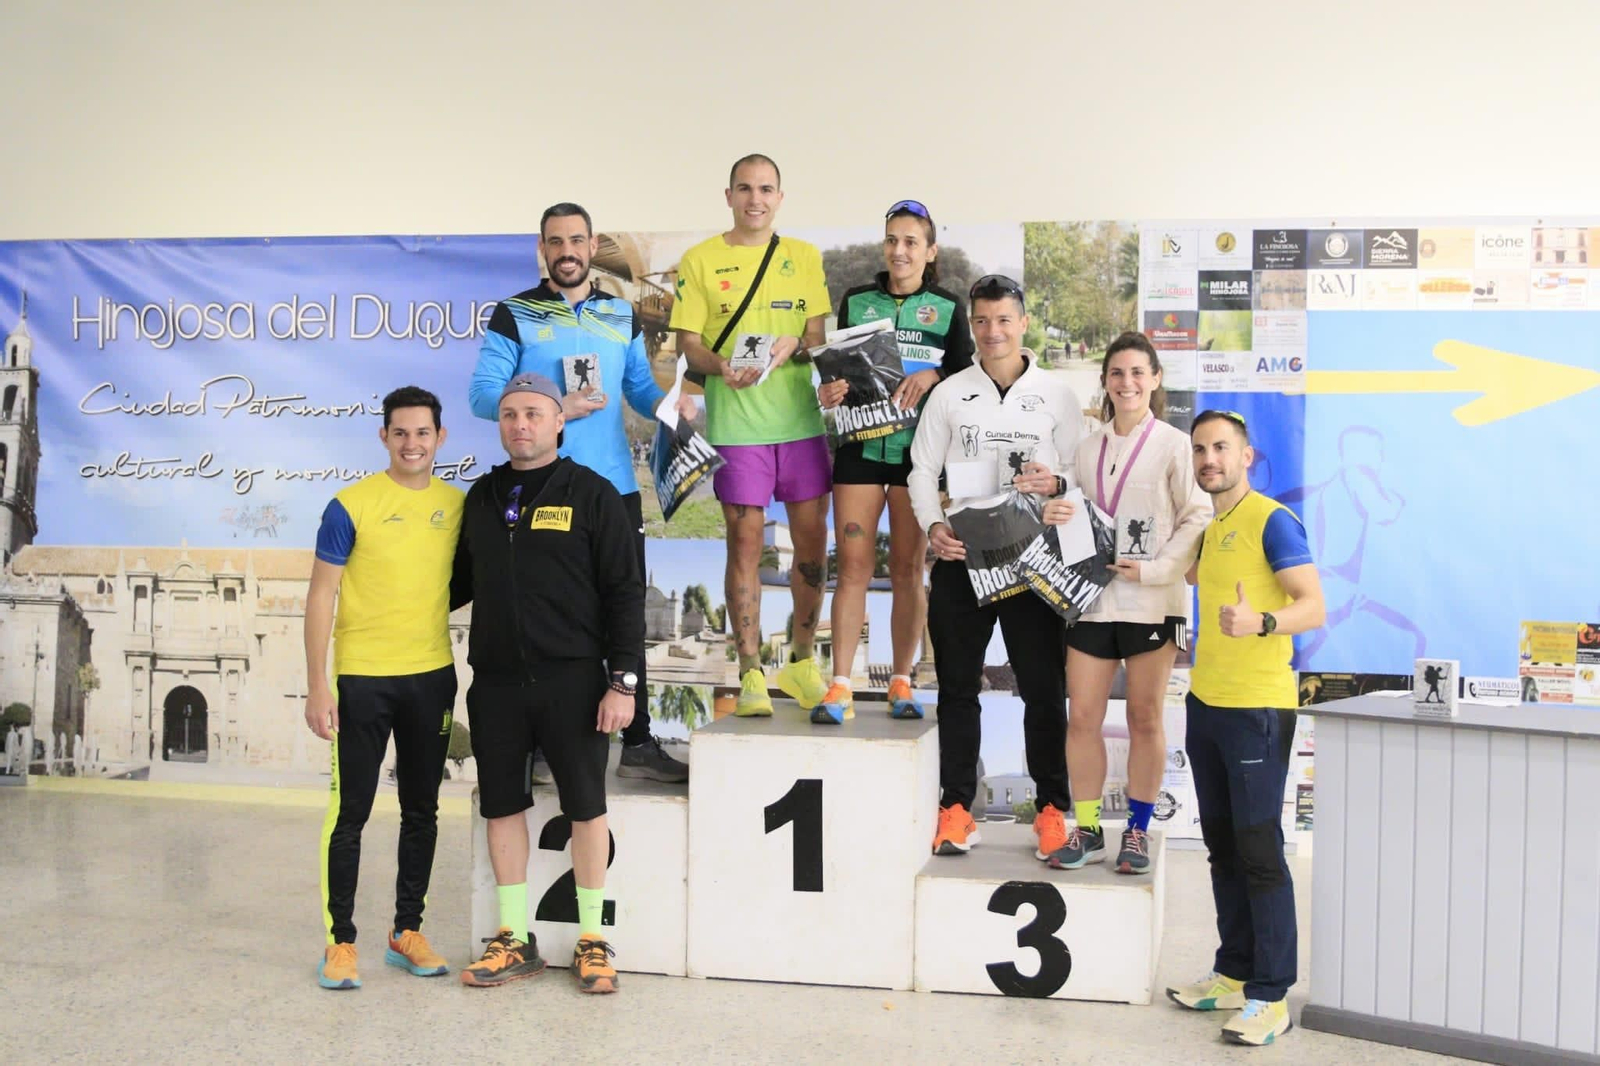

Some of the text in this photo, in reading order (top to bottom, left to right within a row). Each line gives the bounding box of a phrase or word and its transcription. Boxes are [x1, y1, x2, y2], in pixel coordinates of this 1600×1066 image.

[1481, 233, 1524, 248] icône
[1210, 281, 1248, 289] MILAR
[72, 294, 498, 349] Hinojosa del Duque
[896, 330, 923, 343] ISMO
[900, 347, 931, 360] LINOS
[1203, 363, 1230, 372] VELASCO
[79, 374, 385, 419] Ciudad Patrimoni
[79, 451, 485, 495] cultural y monumtal
[535, 510, 569, 523] BROOKLYN
[968, 562, 1020, 600] BROO
[764, 778, 823, 892] 1
[535, 811, 615, 926] 2
[986, 880, 1072, 998] 3
